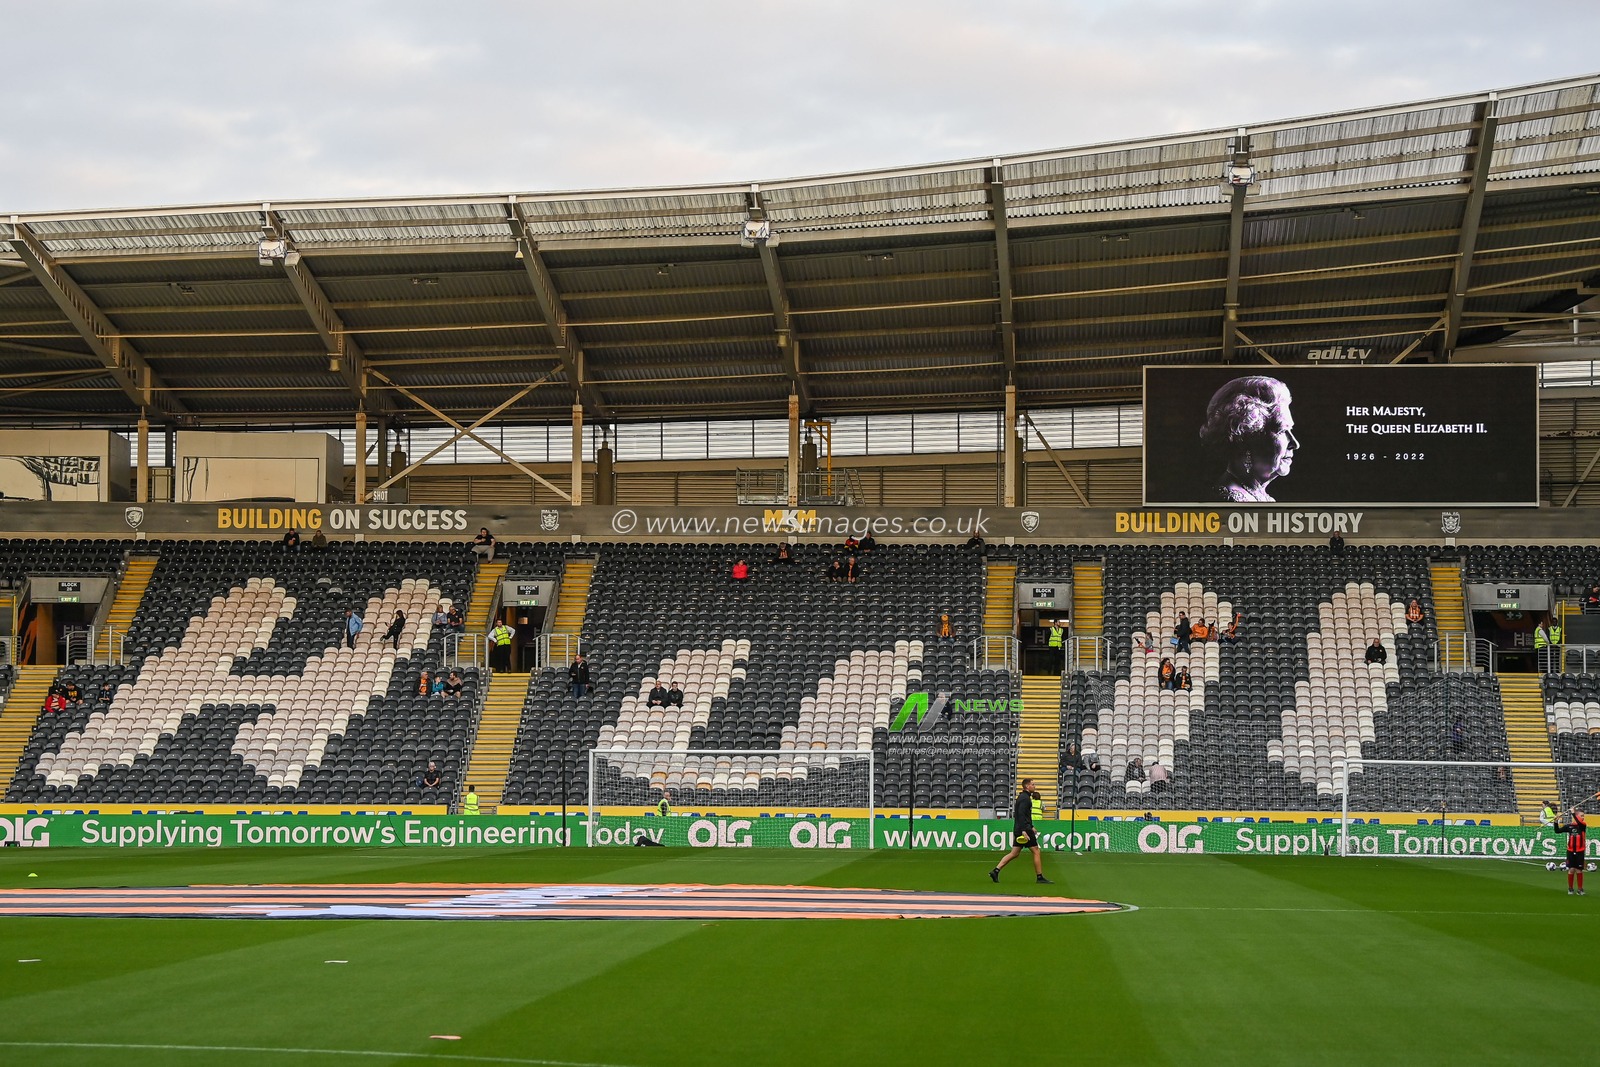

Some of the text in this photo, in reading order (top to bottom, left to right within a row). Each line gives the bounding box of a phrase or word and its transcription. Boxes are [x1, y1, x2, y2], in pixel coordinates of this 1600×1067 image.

[1307, 346, 1372, 360] adi.tv
[1476, 423, 1488, 434] II.
[373, 491, 388, 501] SHOT
[217, 508, 468, 530] BUILDING ON SUCCESS
[764, 509, 816, 526] MKM
[1115, 512, 1364, 533] BUILDING ON HISTORY
[81, 819, 222, 847] Supplying
[230, 819, 395, 844] Tomorrow's
[405, 820, 571, 847] Engineering
[579, 820, 664, 846] Today
[687, 820, 753, 848] OLG
[789, 821, 852, 849] OLG
[884, 825, 1109, 851] www.olg.com
[1137, 824, 1203, 853] OLG
[1236, 828, 1378, 855] Supplying
[1387, 830, 1557, 856] Tomorrow's
